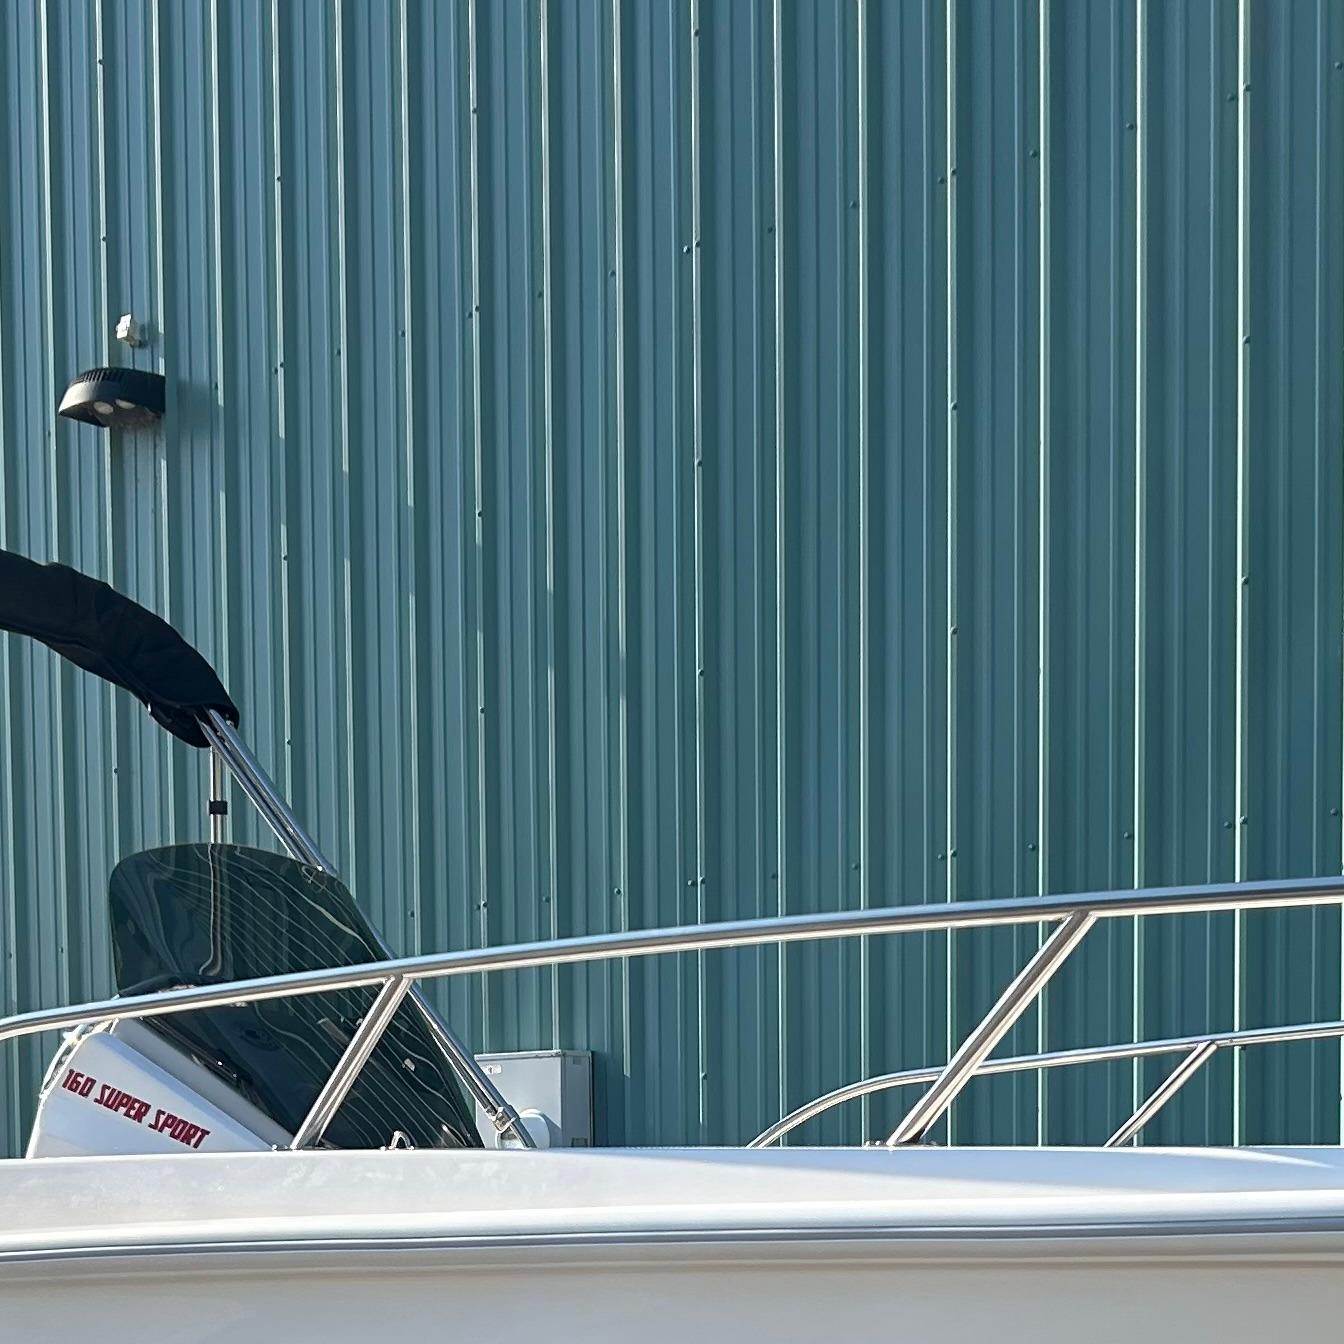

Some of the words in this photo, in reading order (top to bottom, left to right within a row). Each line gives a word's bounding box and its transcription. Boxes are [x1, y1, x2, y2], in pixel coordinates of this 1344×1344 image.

[61, 1068, 97, 1099] 160
[93, 1083, 152, 1124] SUPER
[148, 1108, 211, 1149] SPORT
